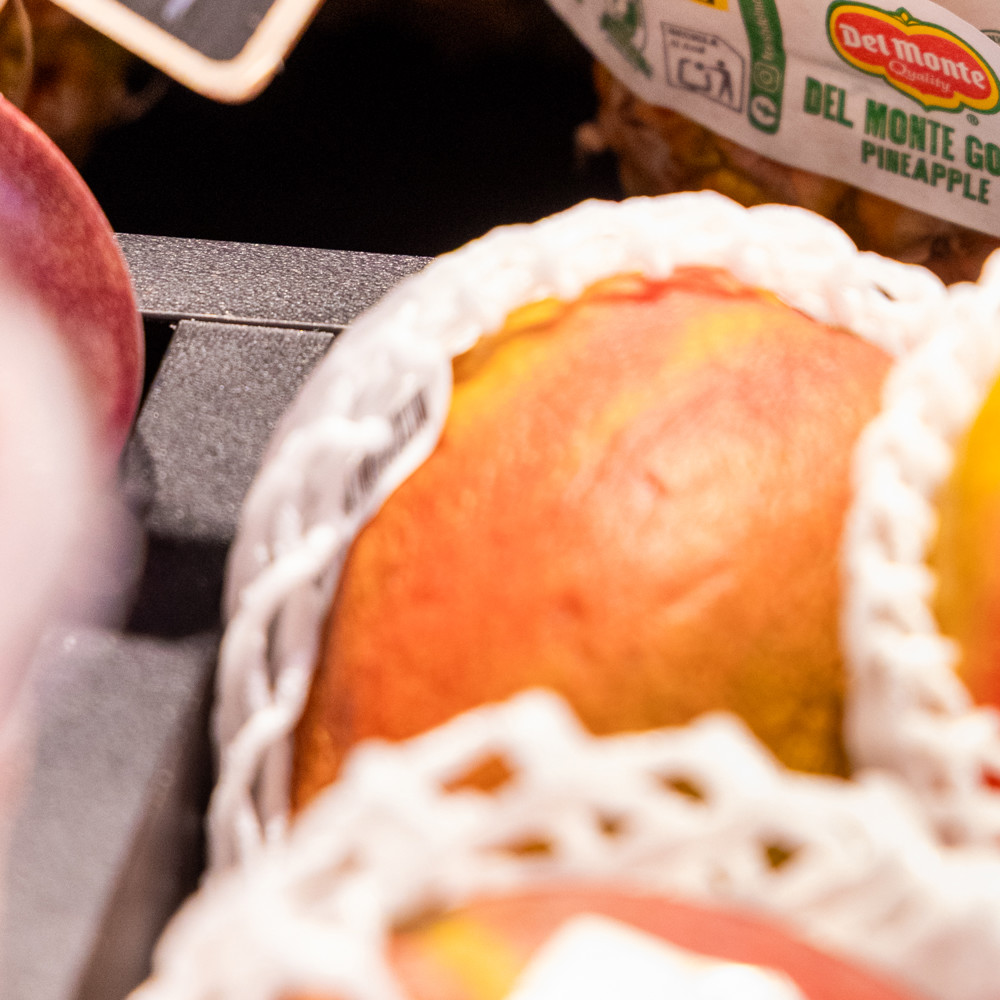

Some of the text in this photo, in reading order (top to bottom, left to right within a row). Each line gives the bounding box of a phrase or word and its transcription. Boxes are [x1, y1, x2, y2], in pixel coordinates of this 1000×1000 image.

[839, 22, 987, 90] Del Monte
[888, 59, 952, 94] Quality
[803, 74, 855, 130] DEL
[864, 97, 956, 162] MONTE
[861, 138, 991, 205] PINEAPPLE
